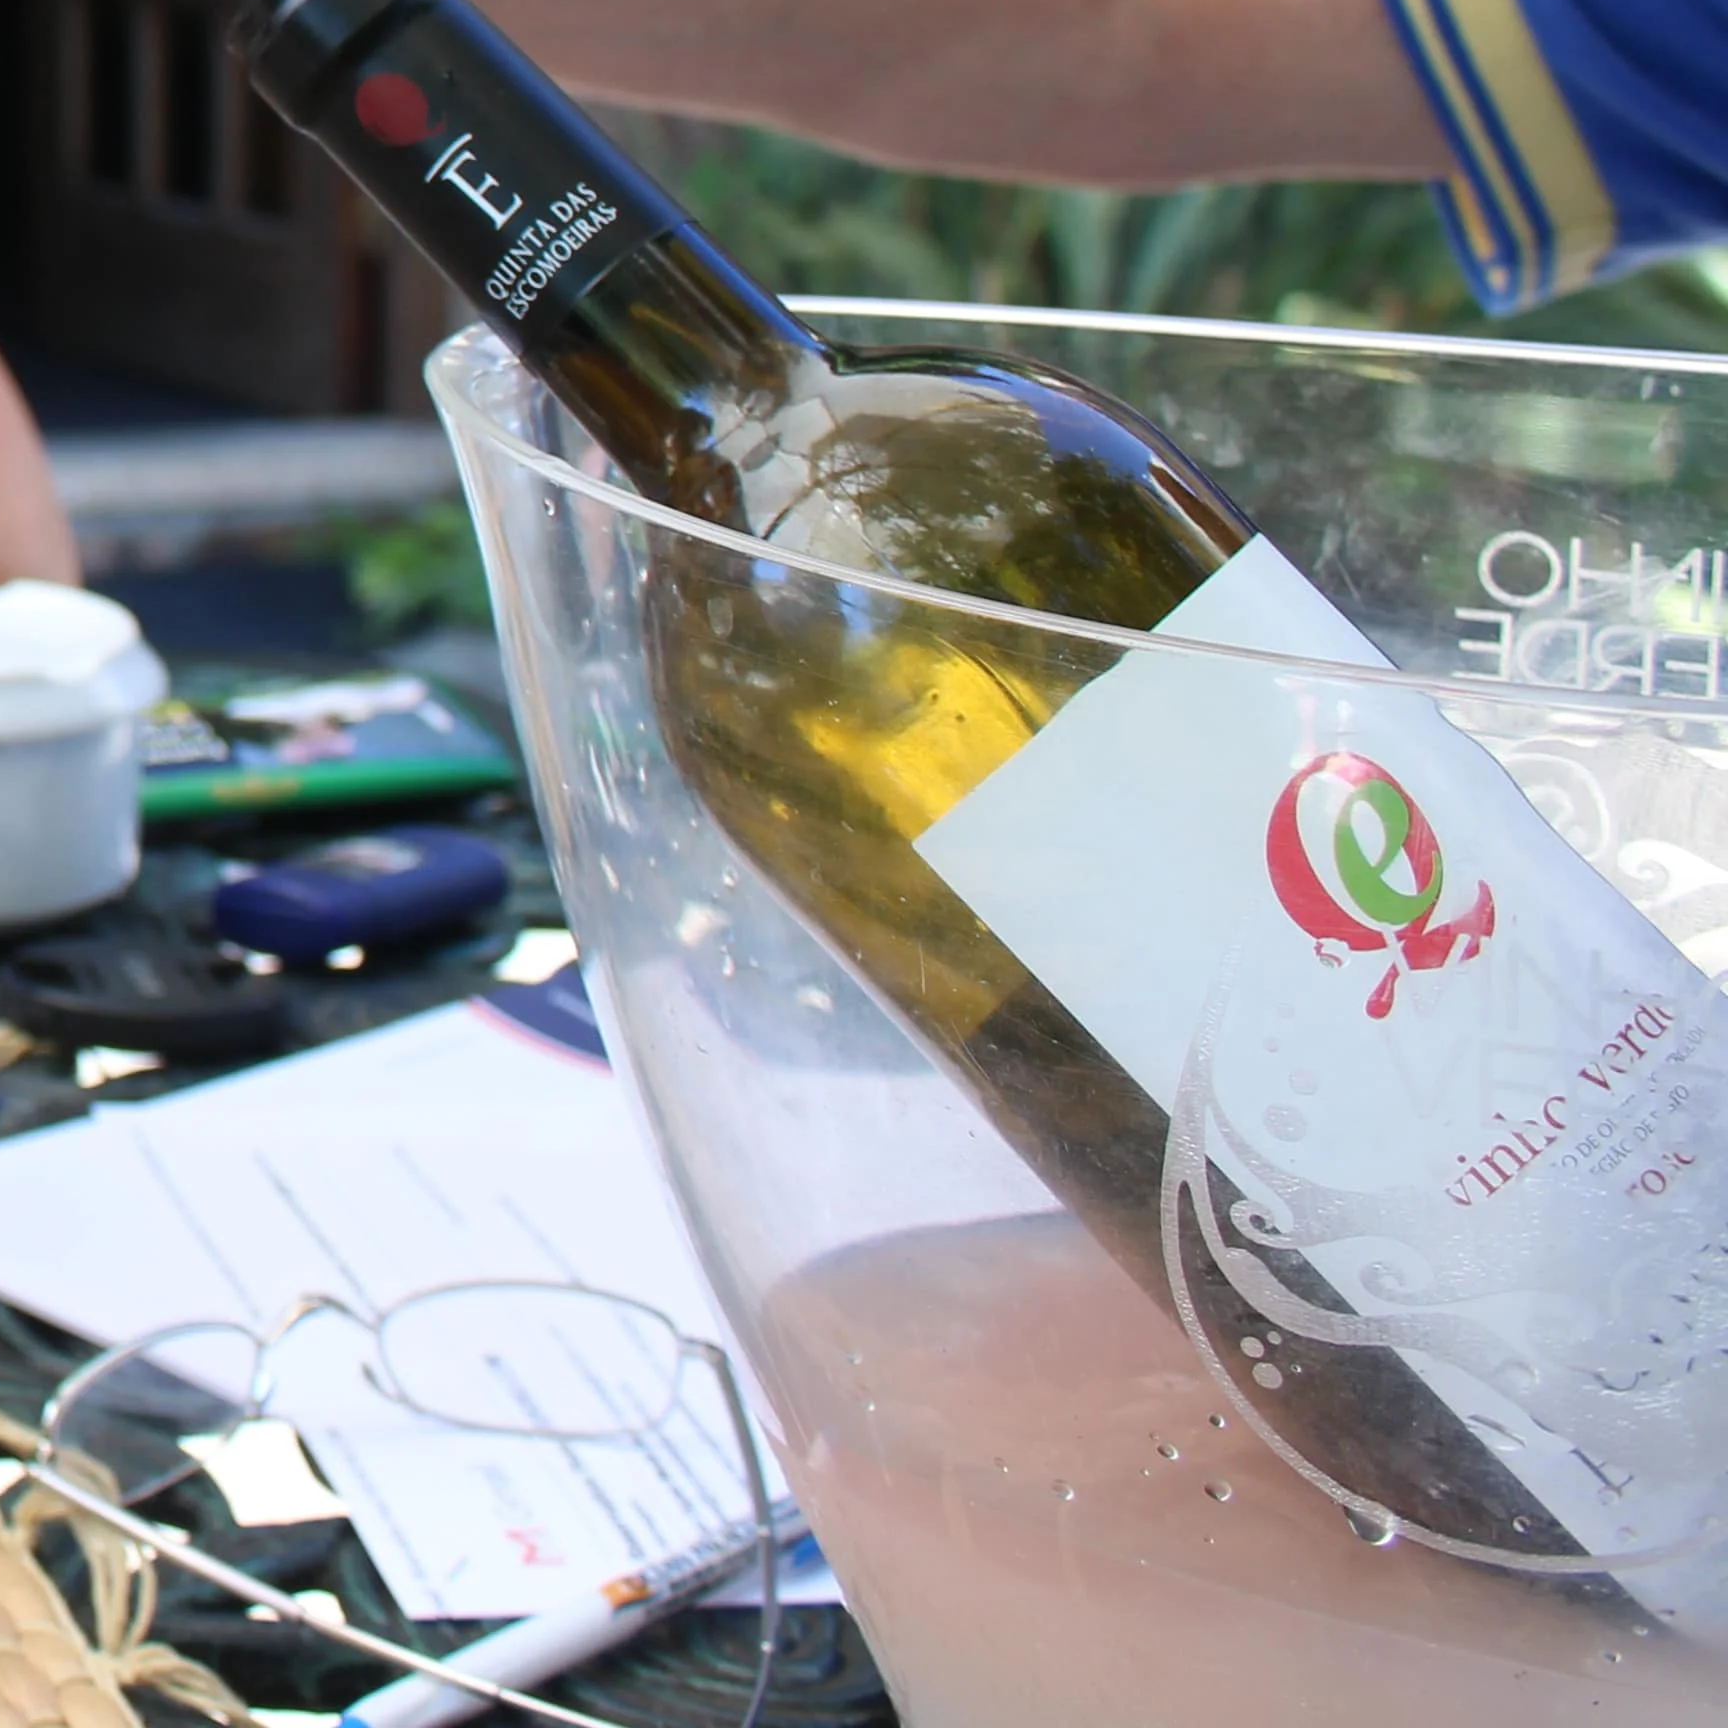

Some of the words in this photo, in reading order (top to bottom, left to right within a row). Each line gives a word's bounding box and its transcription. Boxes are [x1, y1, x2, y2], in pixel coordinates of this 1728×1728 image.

[485, 218, 557, 301] QUINTA
[549, 182, 598, 223] DAS
[505, 201, 618, 320] ESCOMOEIRAS
